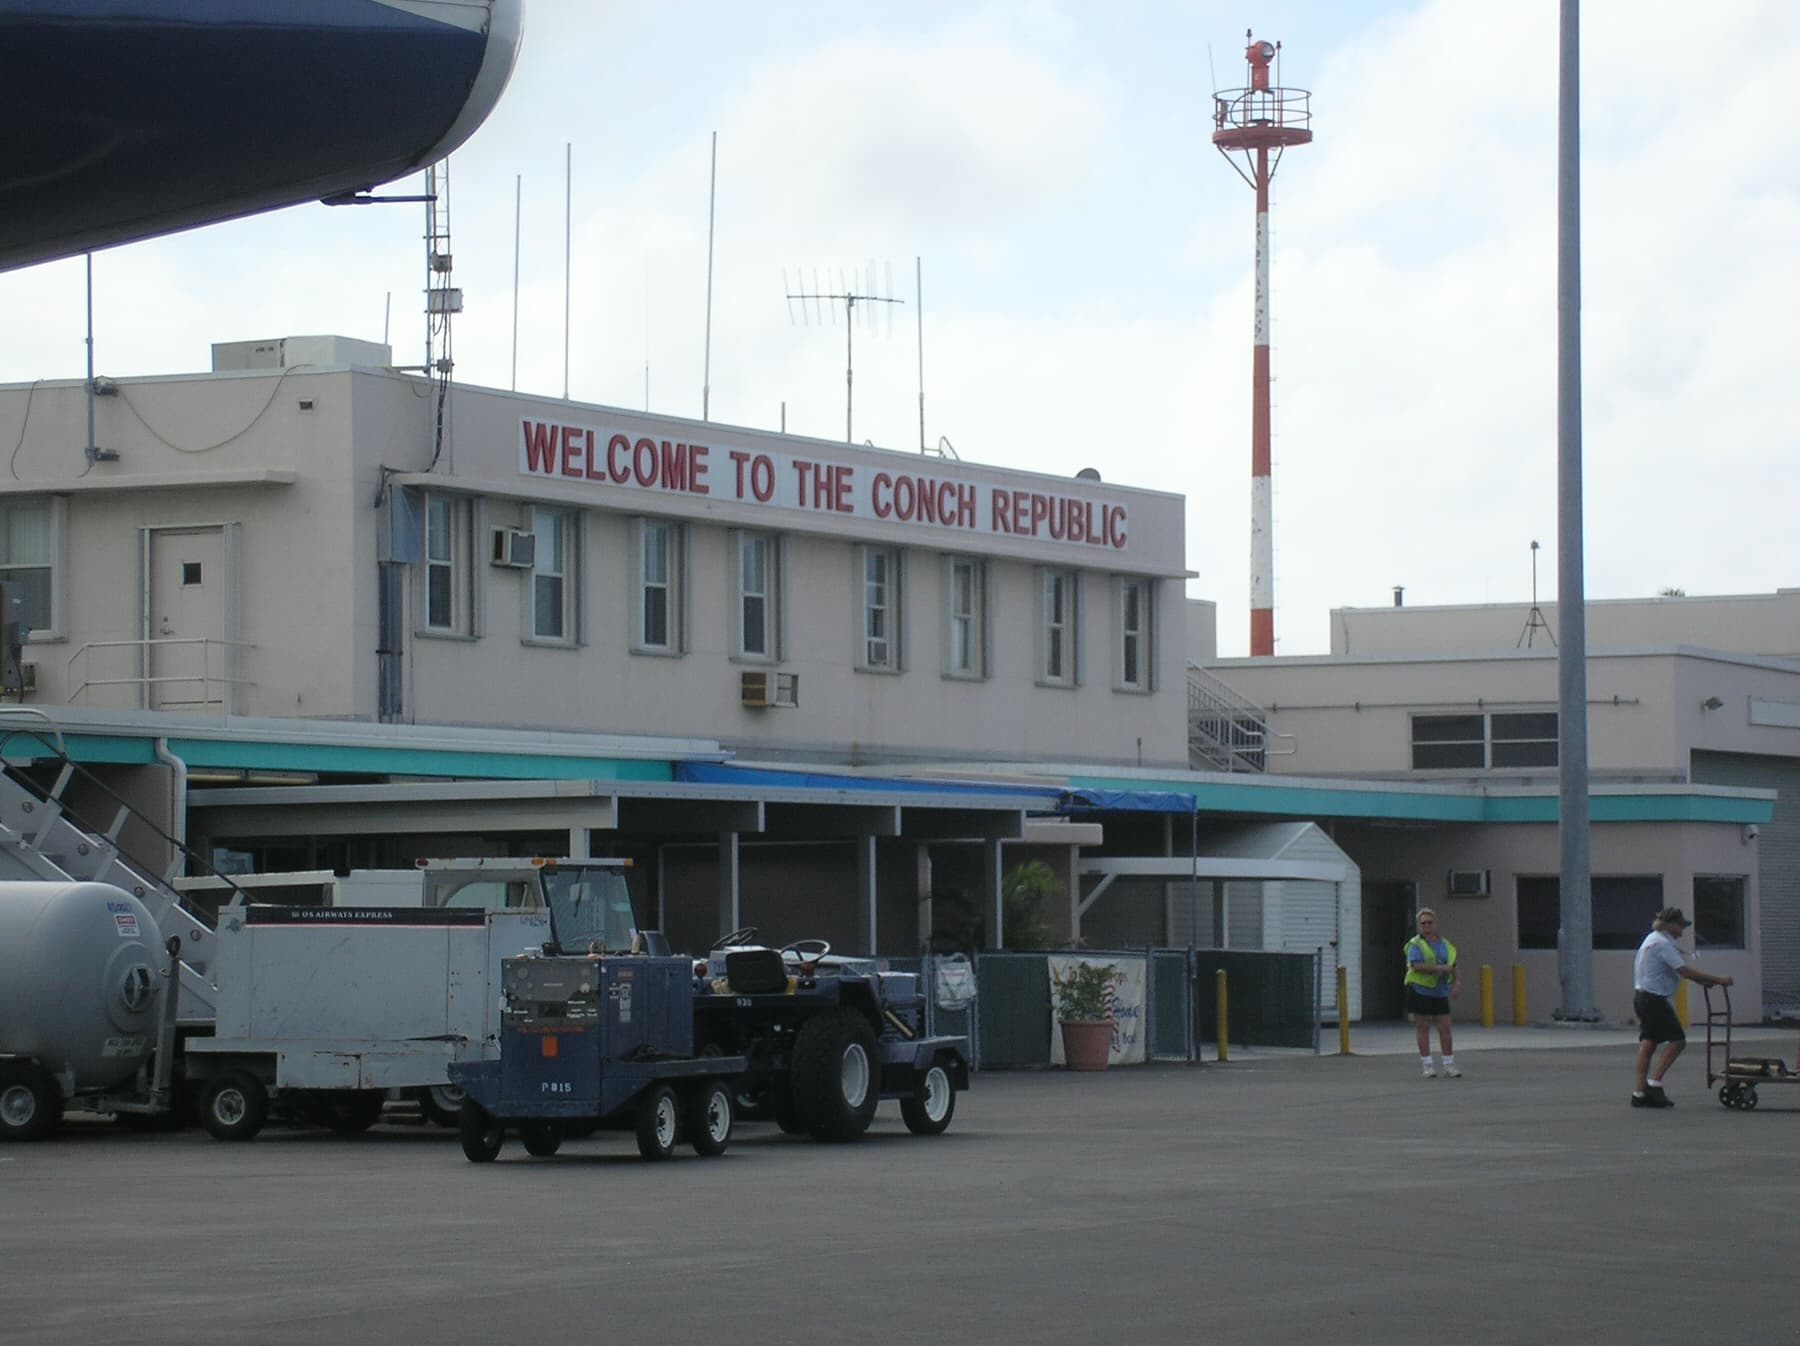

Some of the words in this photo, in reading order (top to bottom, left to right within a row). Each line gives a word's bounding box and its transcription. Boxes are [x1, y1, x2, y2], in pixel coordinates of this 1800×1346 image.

[523, 420, 710, 494] WELCOME
[729, 450, 775, 502] TO
[793, 460, 854, 513] THE
[872, 472, 976, 528] CONCH
[992, 487, 1127, 548] REPUBLIC
[315, 911, 353, 919] AIRWAYS
[354, 911, 393, 919] EXPRESS
